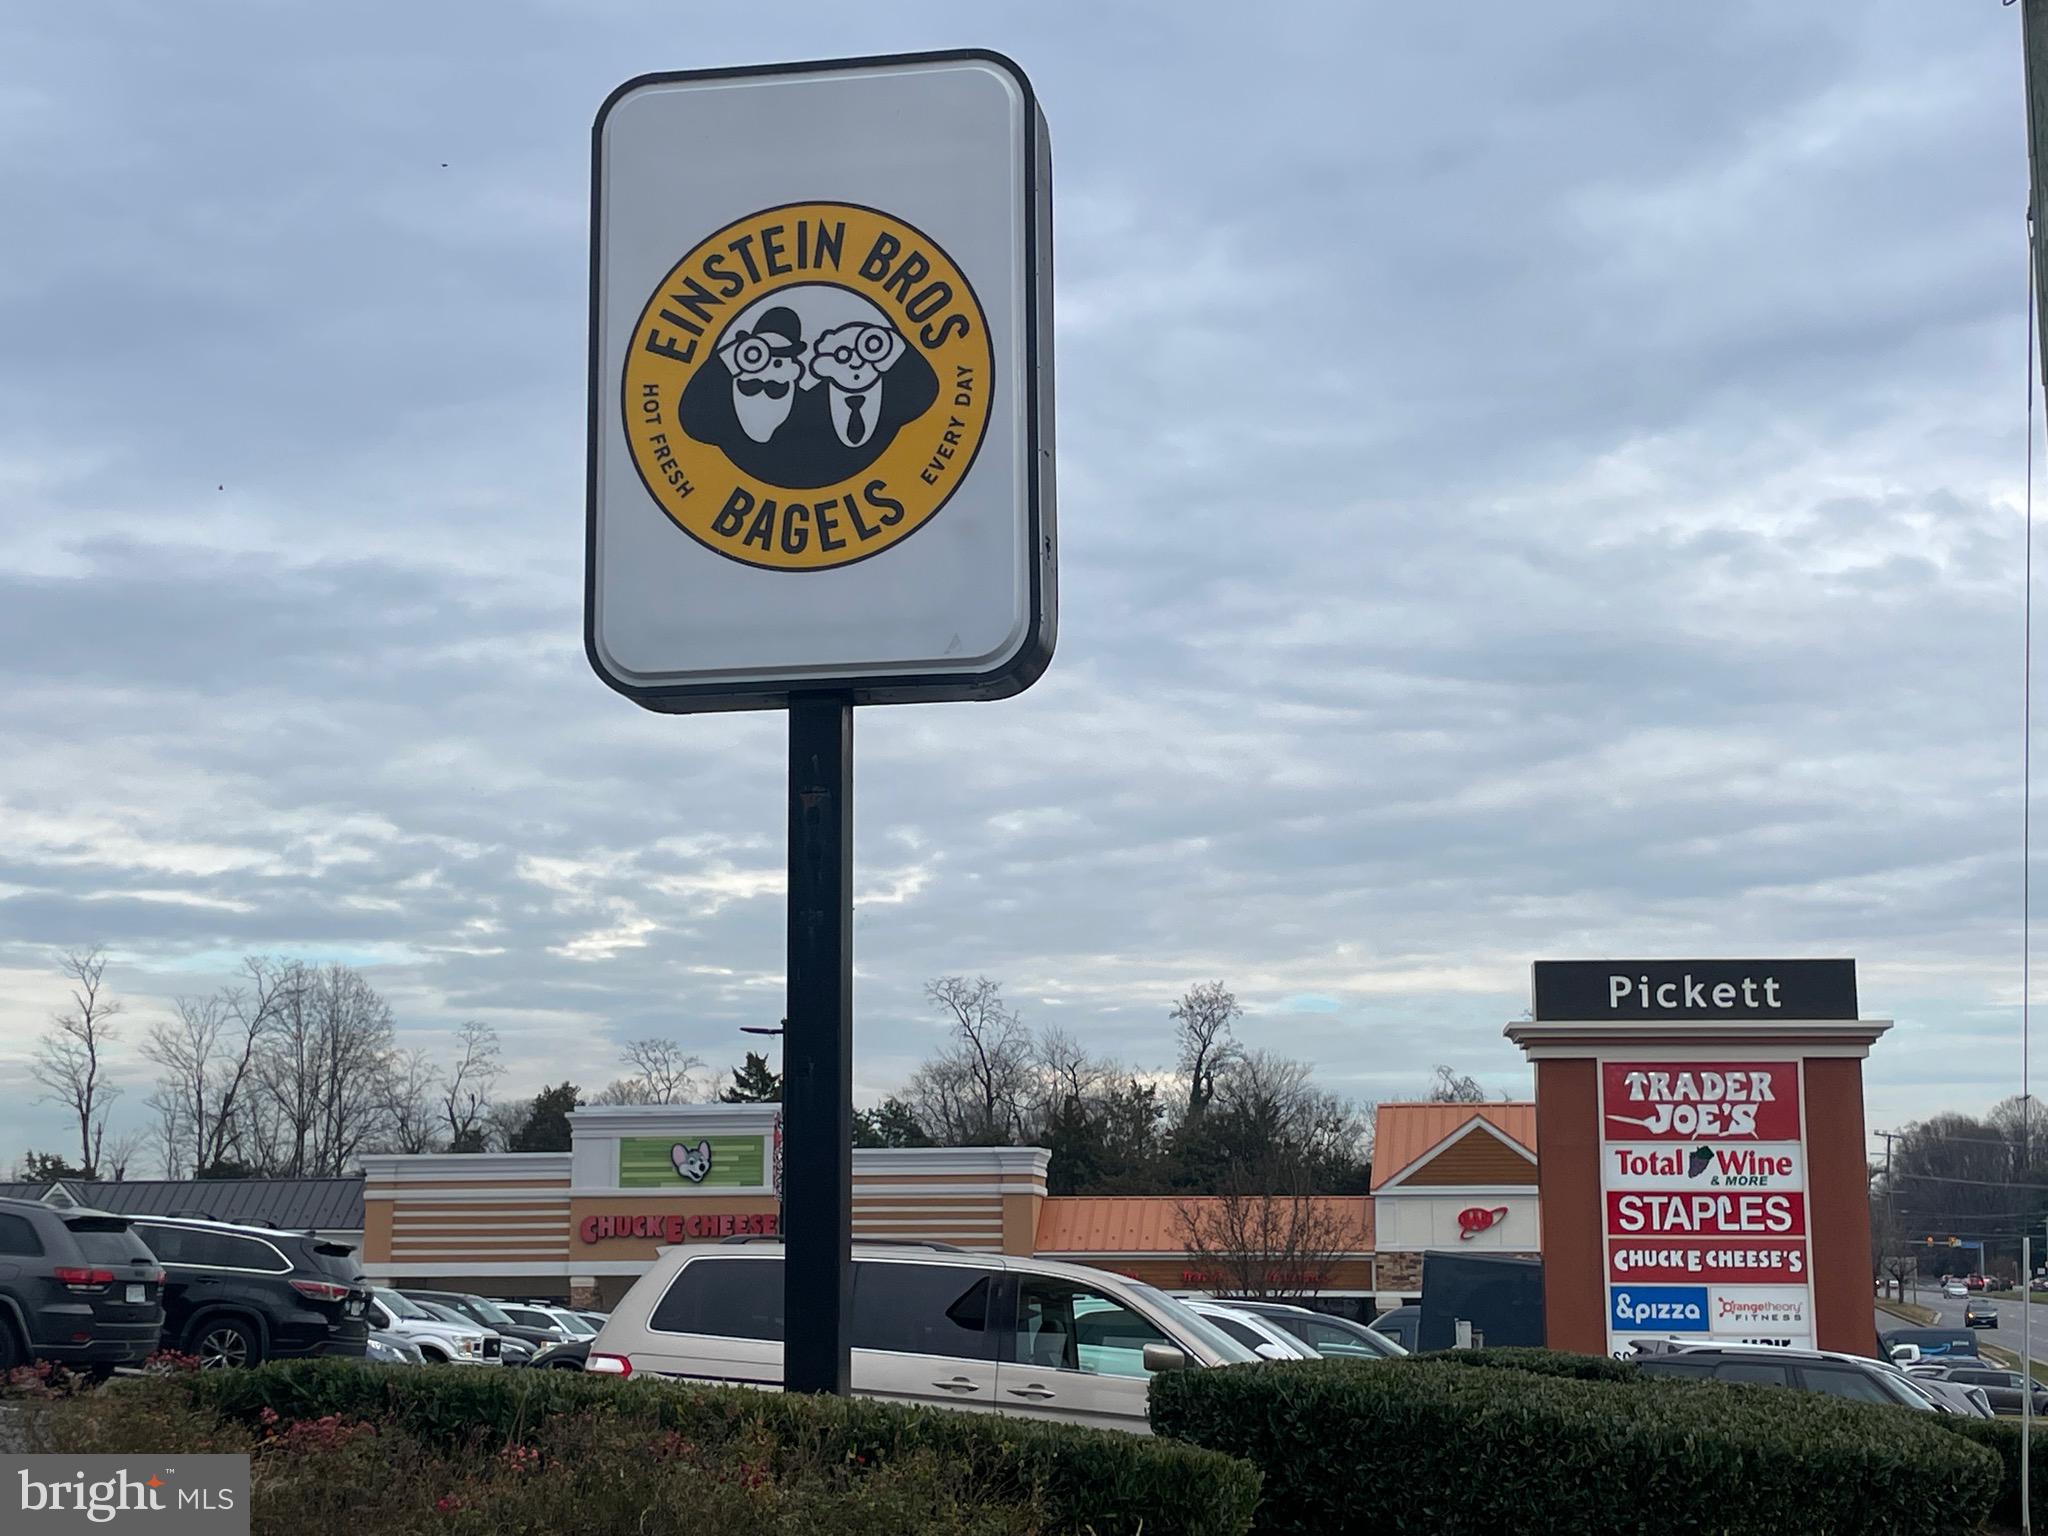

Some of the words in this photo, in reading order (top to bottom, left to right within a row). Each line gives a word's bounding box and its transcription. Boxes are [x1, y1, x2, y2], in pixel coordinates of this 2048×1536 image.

[645, 219, 846, 365] EINSTEIN
[858, 231, 970, 349] BROS
[643, 383, 662, 425] HOT
[920, 416, 966, 486] EVERY
[954, 365, 974, 407] DAY
[649, 434, 695, 499] FRESH
[710, 479, 905, 555] BAGELS
[1608, 974, 1782, 1008] Pickett
[1624, 1072, 1776, 1101] TRADER
[1643, 1103, 1760, 1139] JOE'S
[1615, 1149, 1683, 1176] Total
[1715, 1150, 1793, 1176] Wine
[1710, 1175, 1720, 1186] &
[1725, 1175, 1768, 1186] MORE
[580, 1214, 666, 1244] CHUCK
[666, 1214, 685, 1244] E
[686, 1213, 779, 1237] CHEESE
[1618, 1195, 1793, 1232] STAPLES
[1614, 1250, 1684, 1271] CHUCK
[1687, 1250, 1702, 1272] E
[1705, 1250, 1803, 1273] CHEESE'S
[1616, 1293, 1701, 1324] &pizza
[1735, 1314, 1802, 1322] FITNESS
